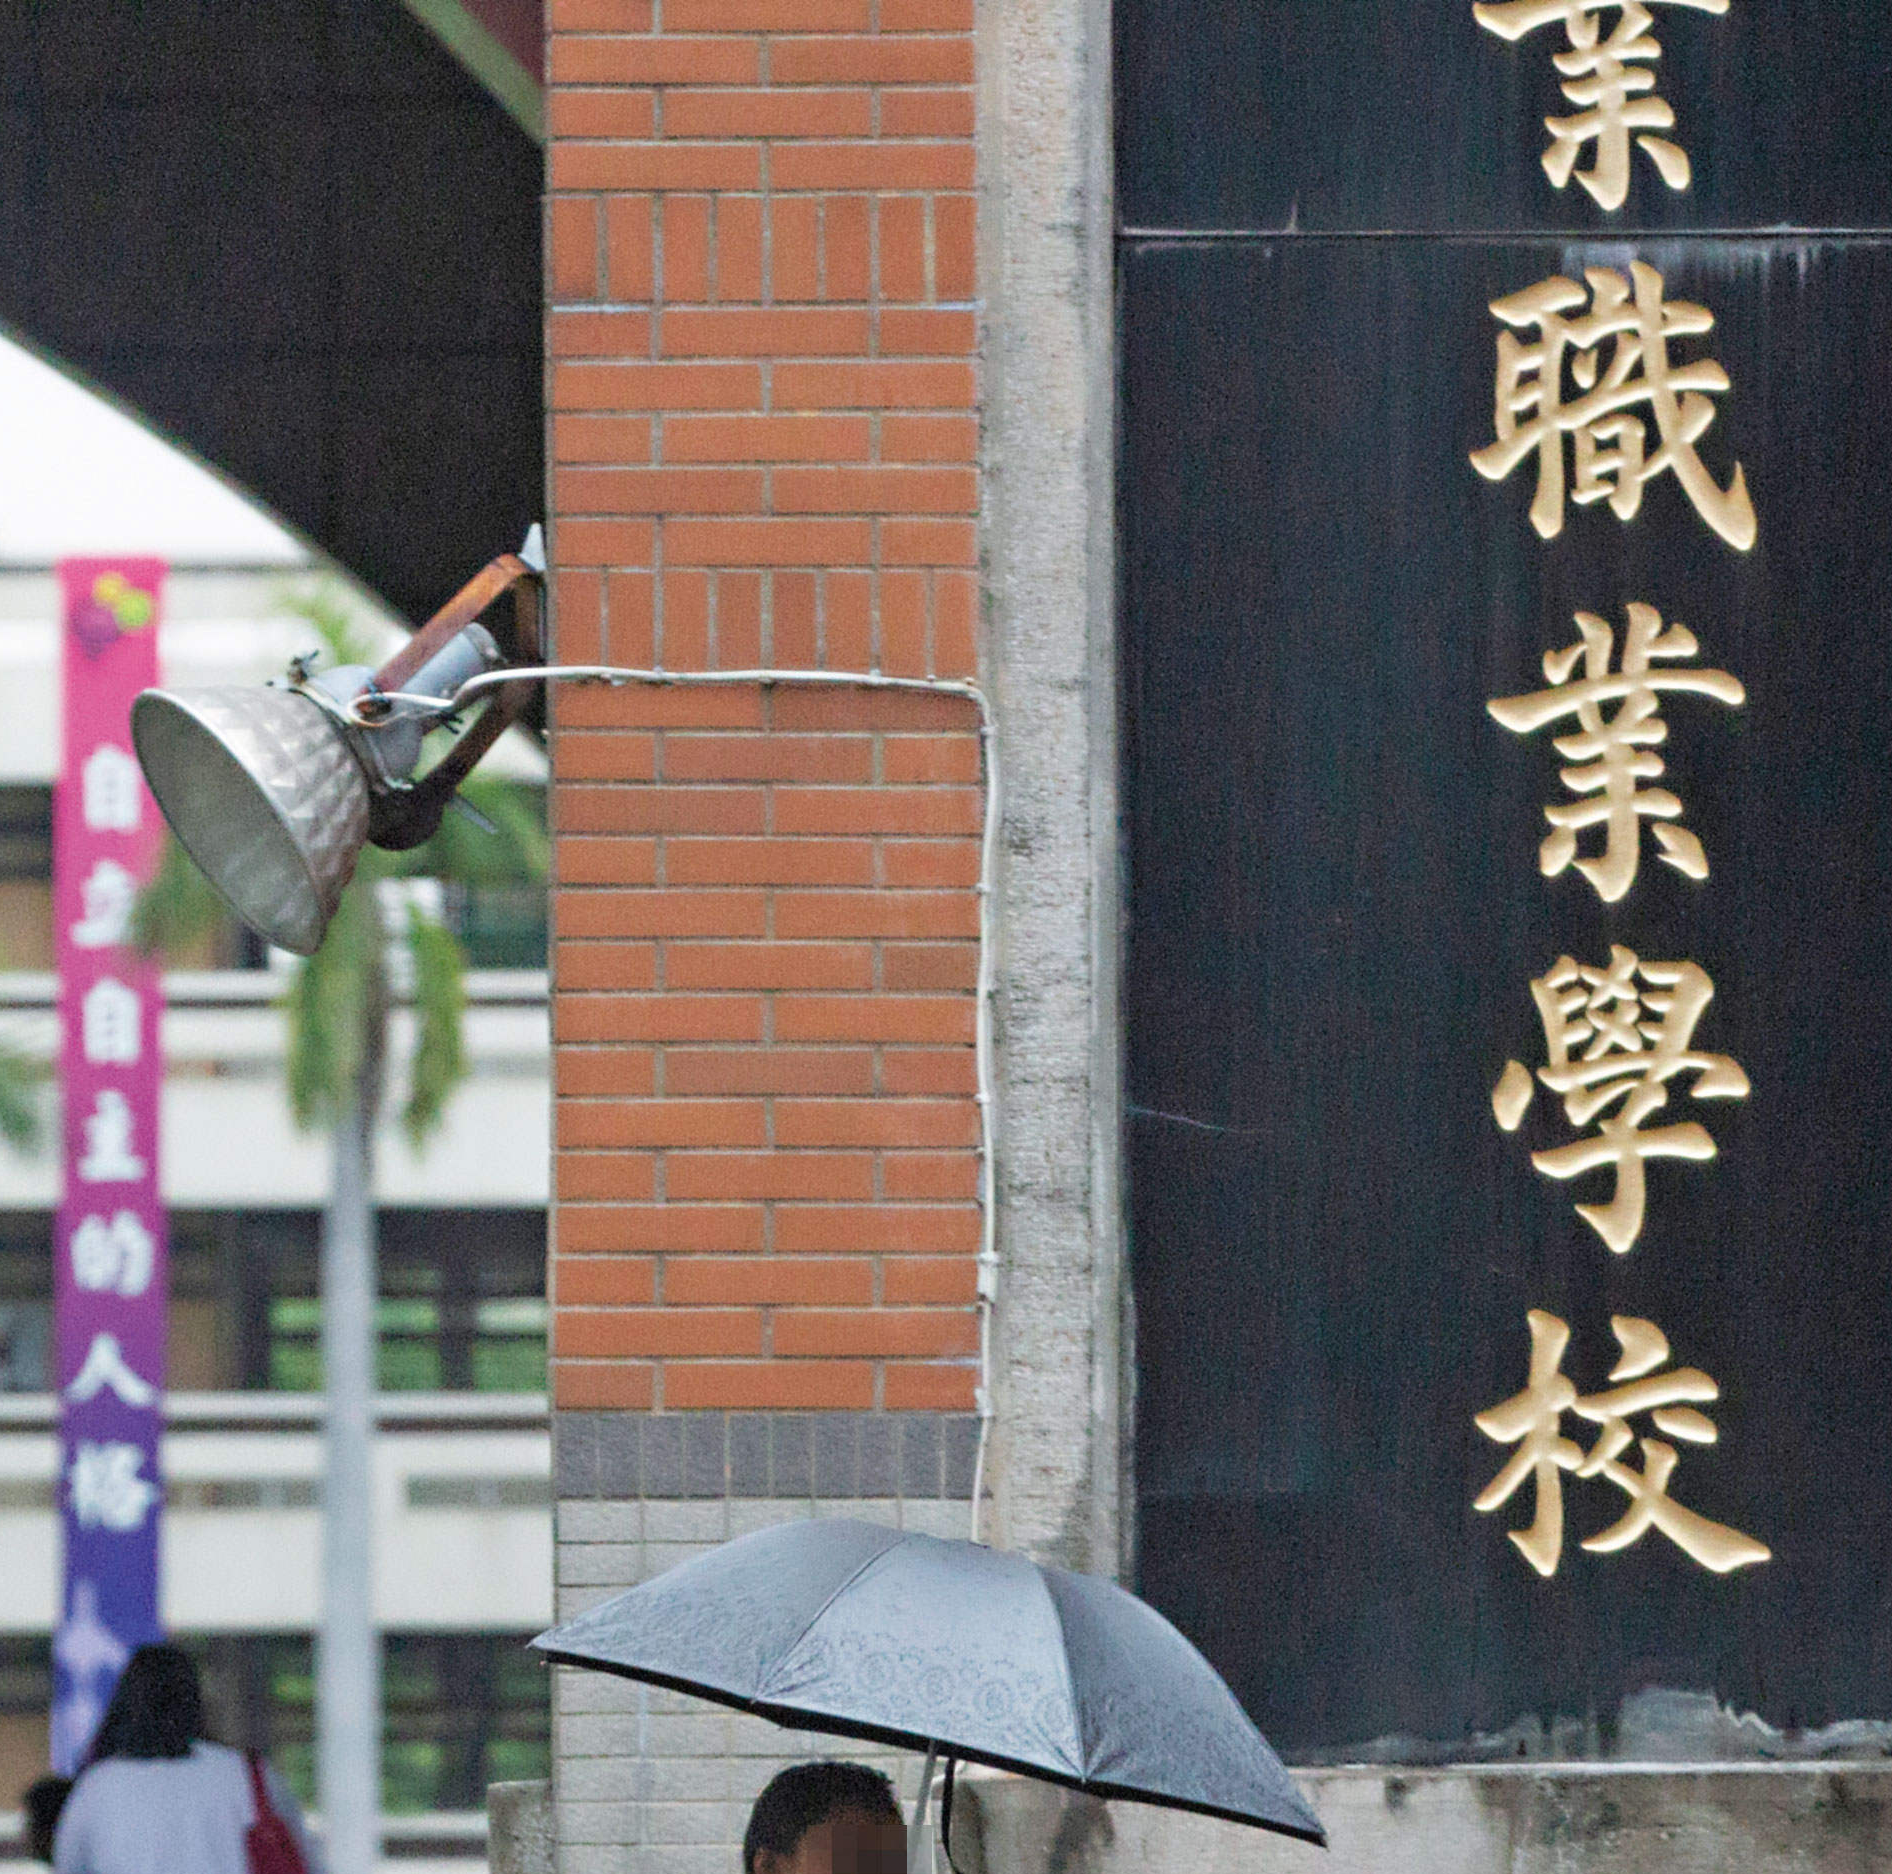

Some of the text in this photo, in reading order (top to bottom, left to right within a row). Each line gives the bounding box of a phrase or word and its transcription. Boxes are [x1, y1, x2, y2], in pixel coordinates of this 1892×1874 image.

[1467, 0, 1775, 1578] 業職業學校
